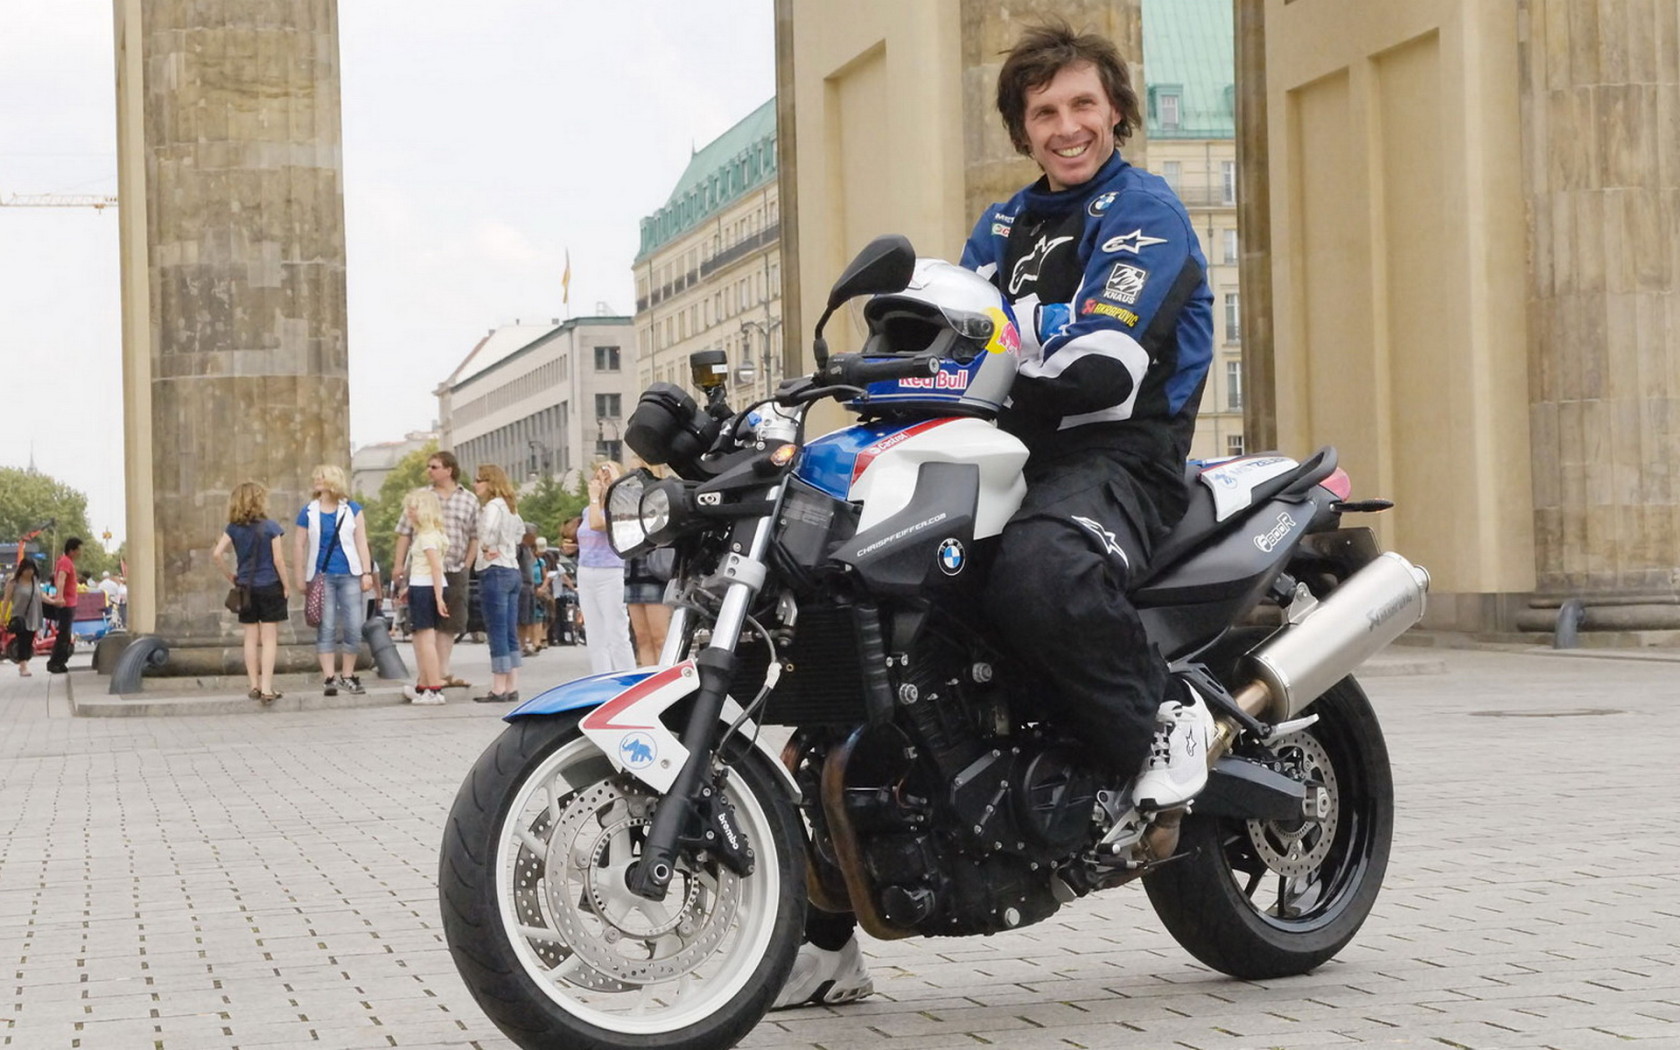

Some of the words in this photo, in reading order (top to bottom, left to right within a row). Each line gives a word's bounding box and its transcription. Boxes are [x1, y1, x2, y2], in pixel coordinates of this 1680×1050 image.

[1103, 290, 1135, 304] KNAUS
[936, 370, 967, 388] Bull
[877, 431, 909, 450] Castrol
[857, 512, 947, 557] CHRISPFEIFFER.COM
[718, 812, 739, 850] brembo
